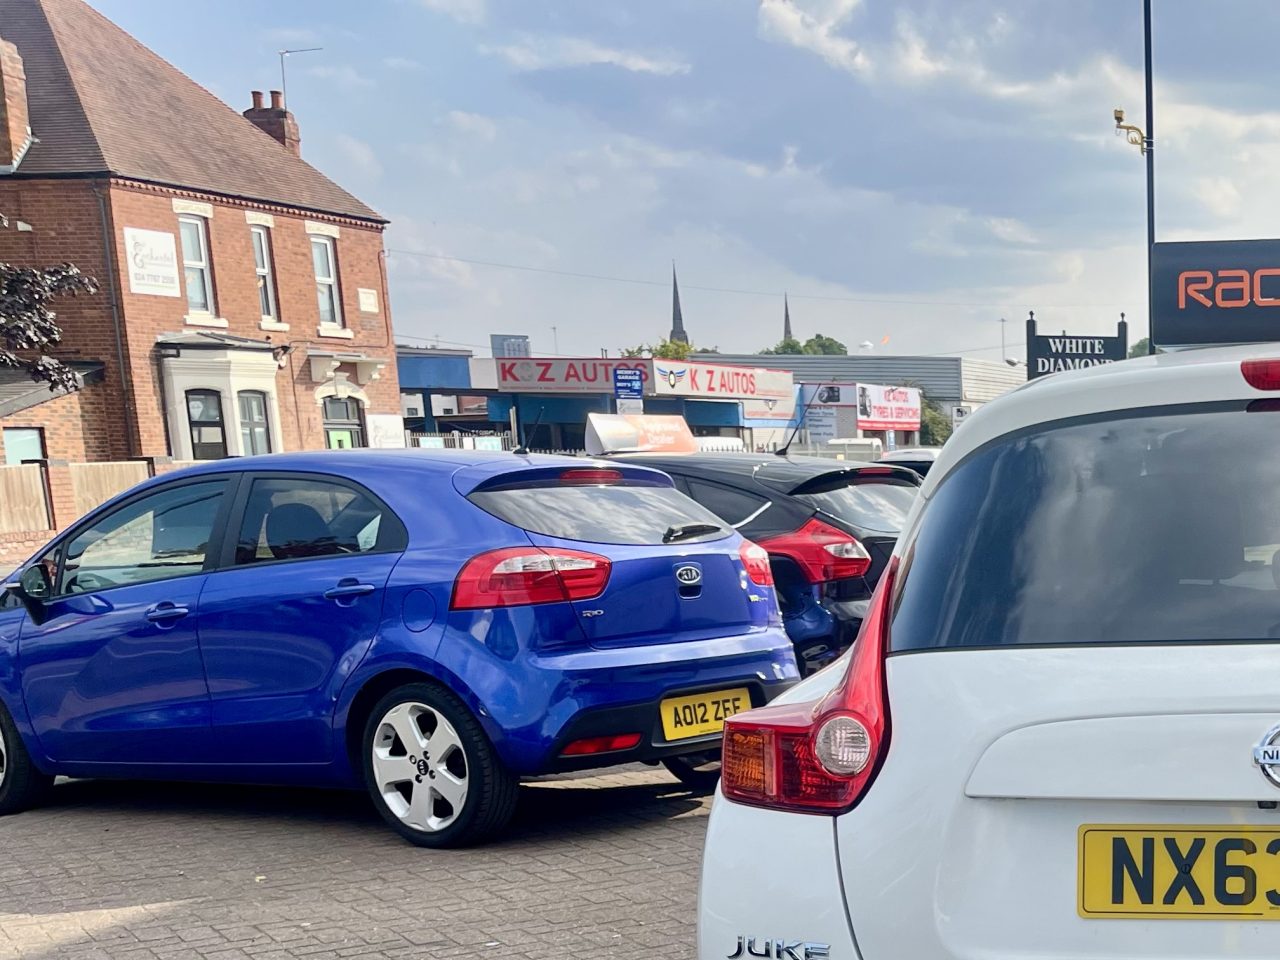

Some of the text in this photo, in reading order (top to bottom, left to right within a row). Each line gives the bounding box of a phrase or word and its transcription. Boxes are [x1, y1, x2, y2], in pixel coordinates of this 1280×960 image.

[1048, 338, 1104, 354] WHITE
[719, 371, 756, 395] AUTOS
[673, 702, 710, 729] AO12
